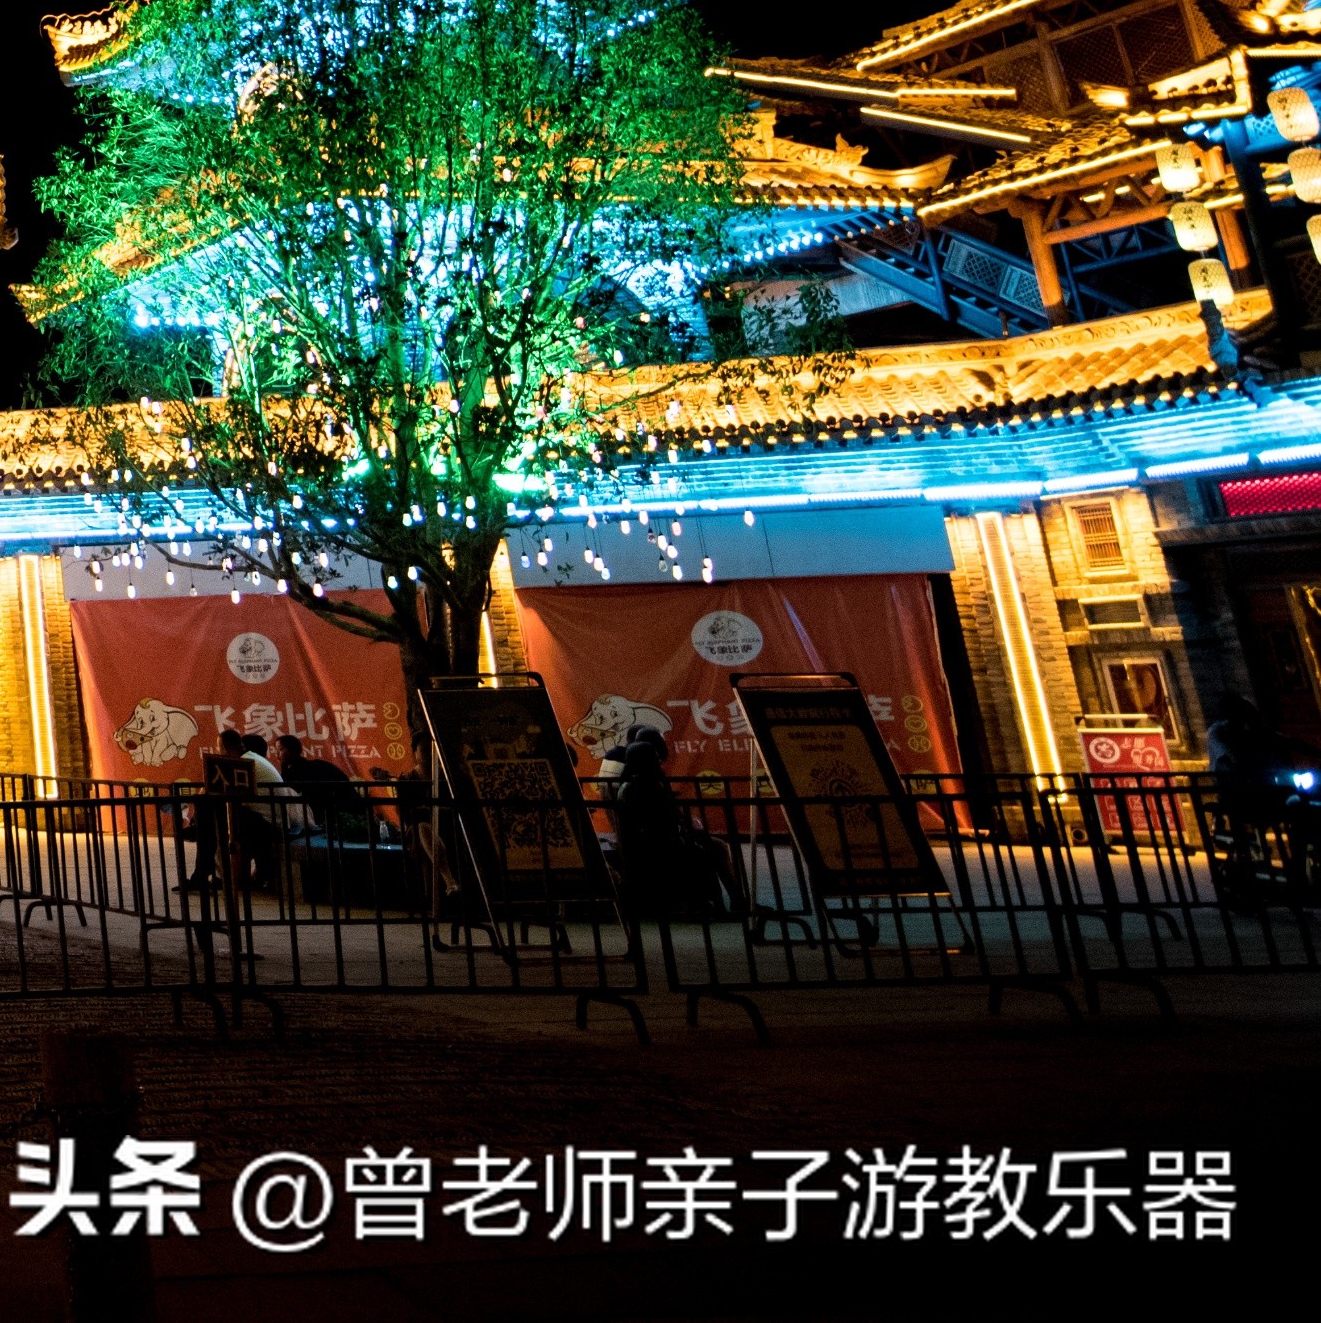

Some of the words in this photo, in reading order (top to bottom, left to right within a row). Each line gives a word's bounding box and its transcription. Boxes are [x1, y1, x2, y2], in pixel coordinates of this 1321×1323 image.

[194, 701, 378, 742] 飞象比萨
[332, 745, 382, 759] PIZZA
[674, 738, 707, 754] FLY
[211, 764, 250, 788] 入口
